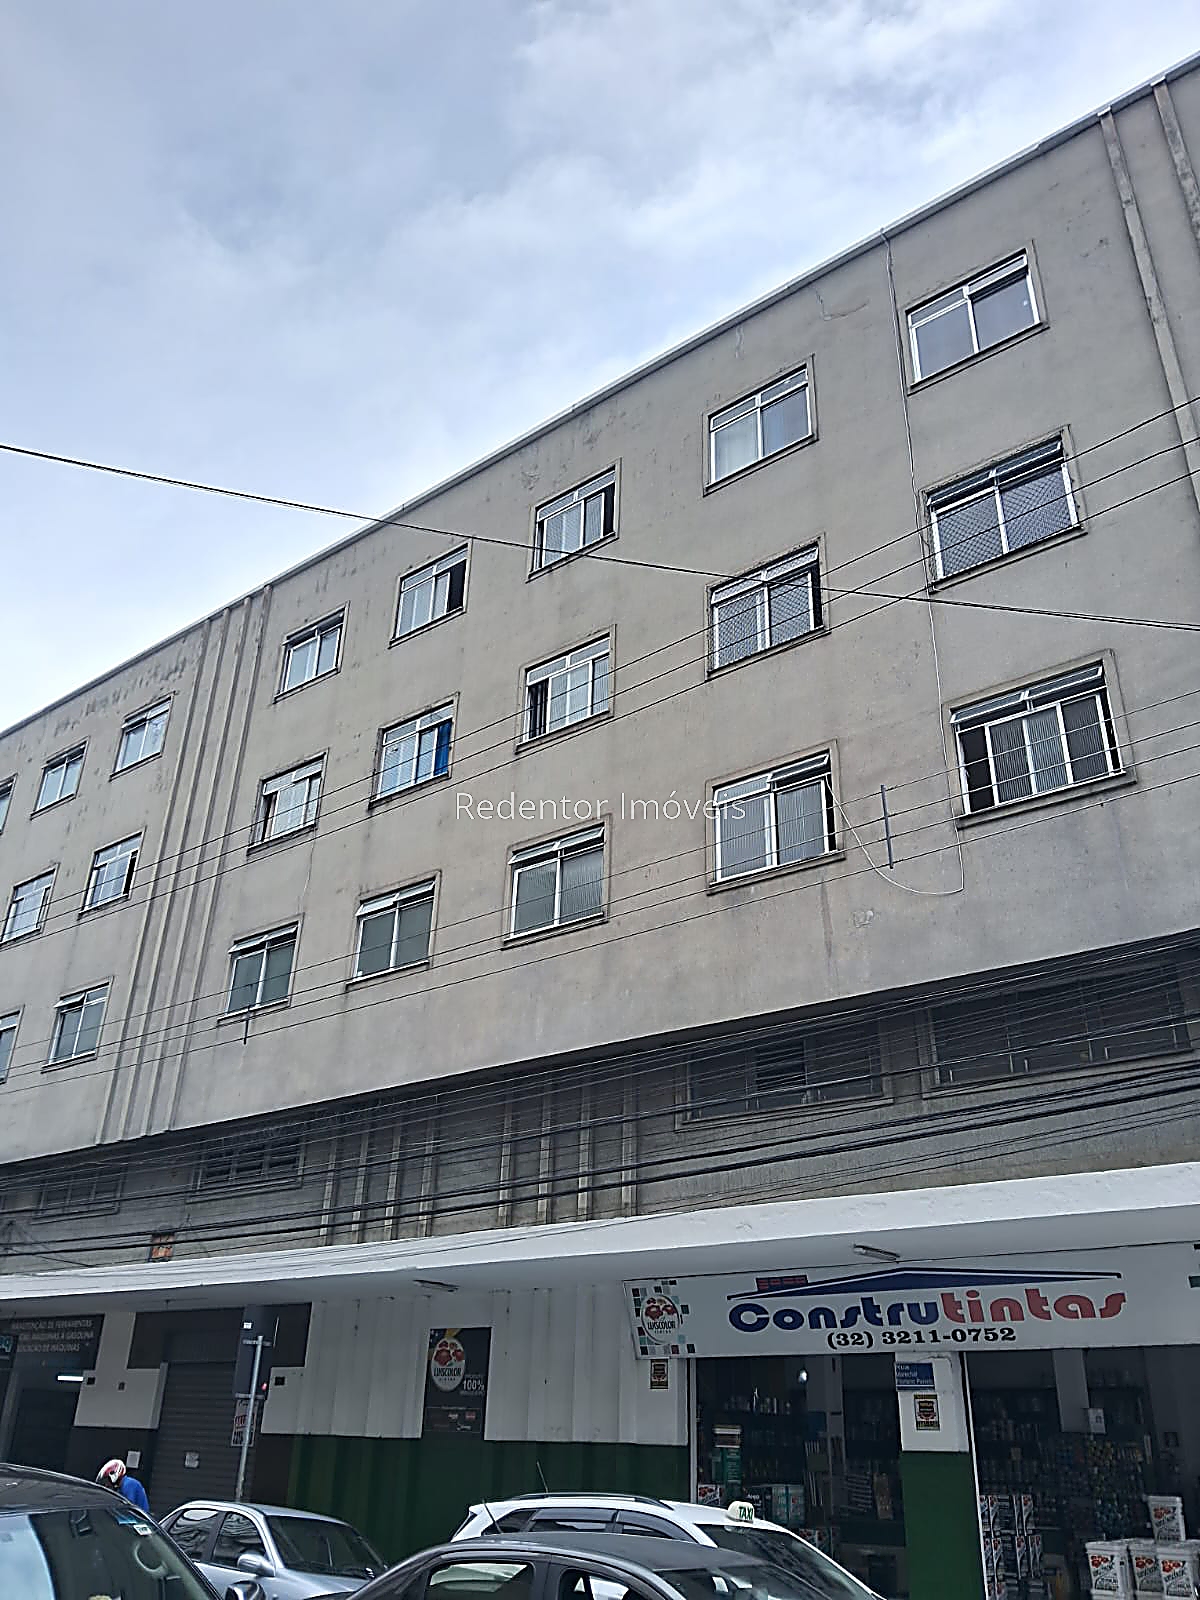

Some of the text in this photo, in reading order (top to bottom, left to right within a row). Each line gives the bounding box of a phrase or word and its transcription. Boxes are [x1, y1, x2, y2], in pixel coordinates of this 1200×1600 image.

[827, 1327, 1016, 1349] (32) 3211-0752
[738, 1506, 754, 1521] TAXI
